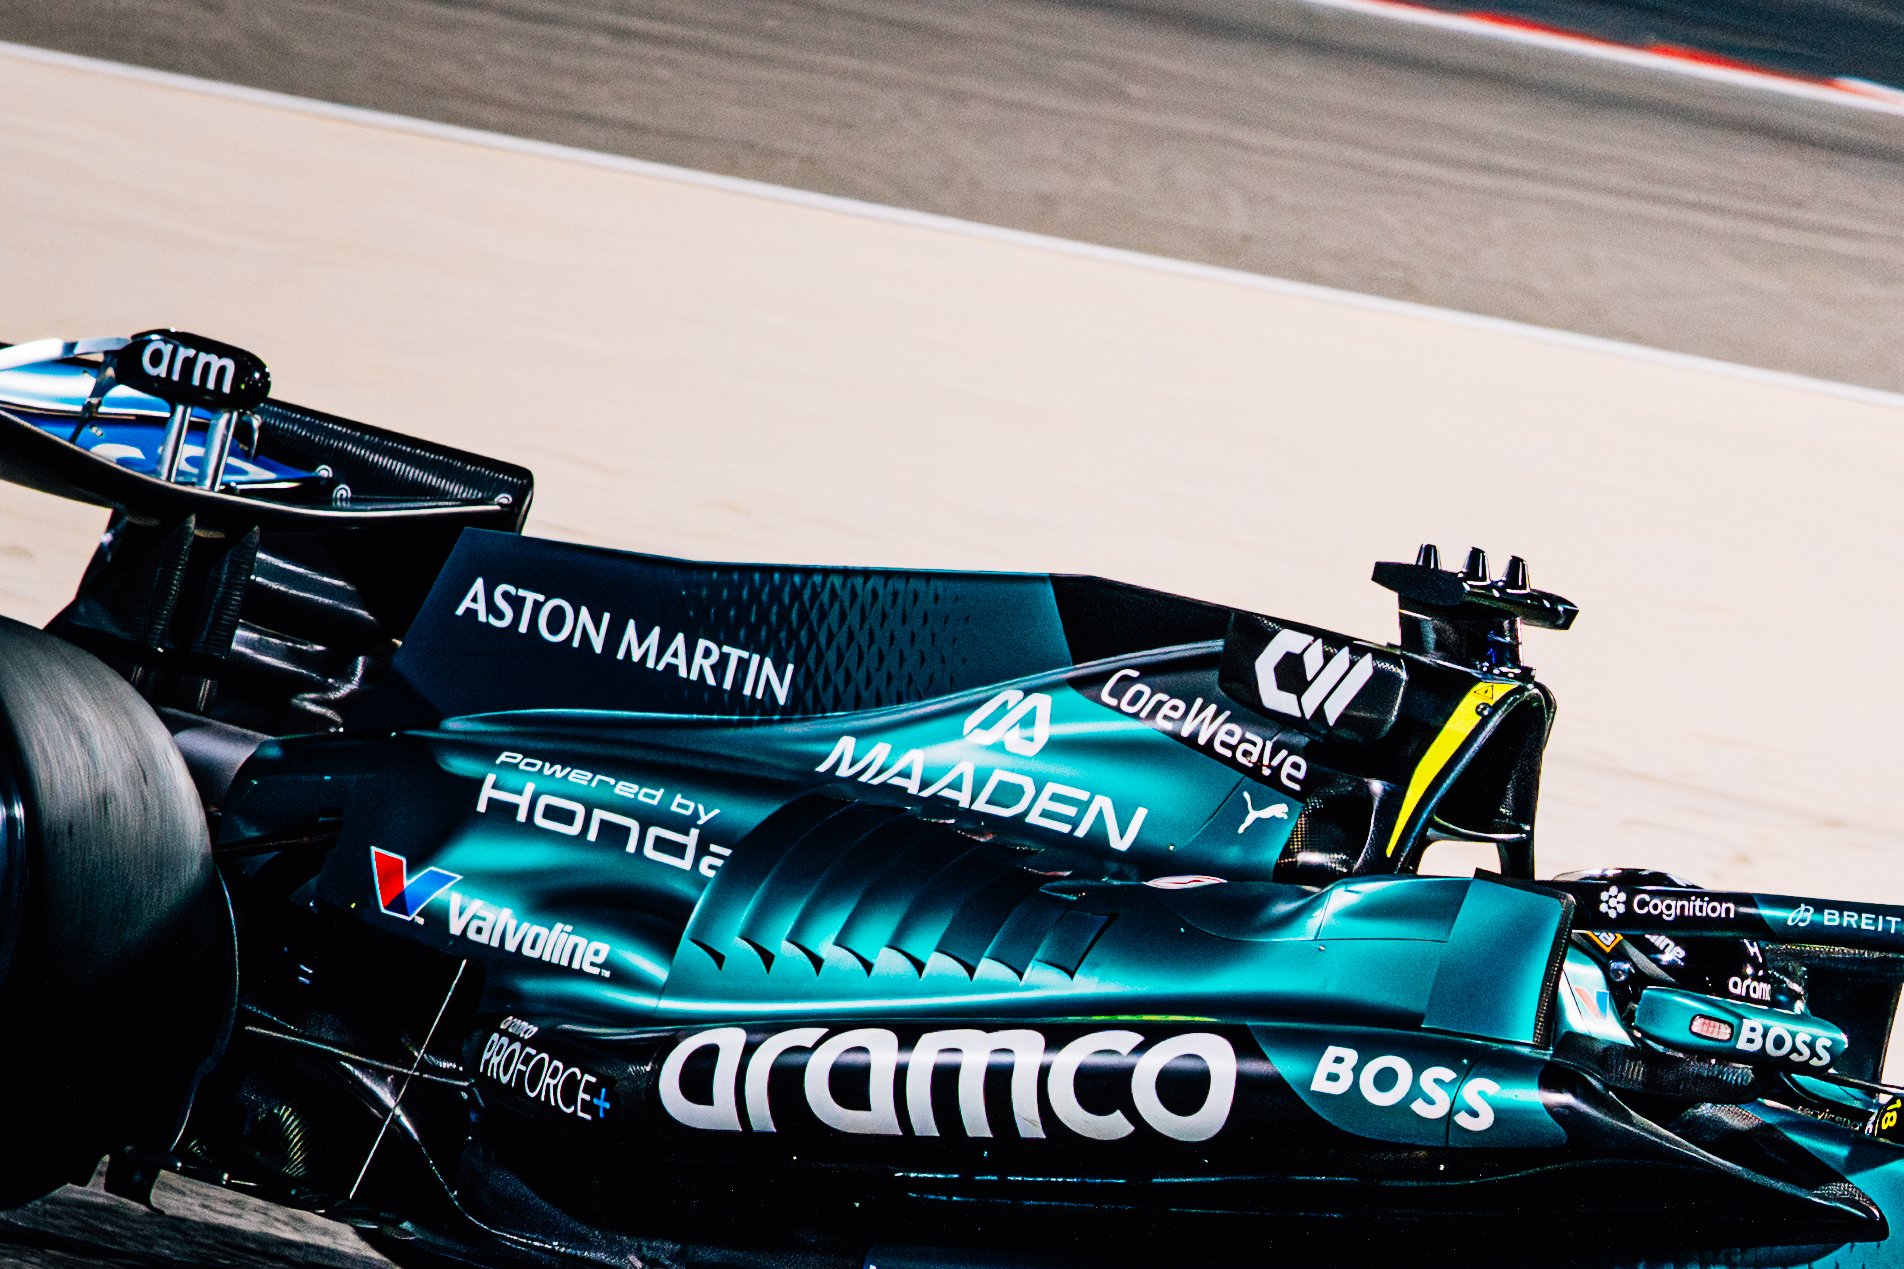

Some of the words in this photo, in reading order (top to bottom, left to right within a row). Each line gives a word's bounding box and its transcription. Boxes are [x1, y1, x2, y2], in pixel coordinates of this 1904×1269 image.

[142, 339, 235, 394] arm
[455, 576, 611, 654] ASTON
[616, 618, 794, 706] MARTIN
[1100, 668, 1308, 791] CoreWeave
[495, 751, 664, 806] Powered
[670, 793, 720, 825] by
[815, 735, 1148, 852] MAADEN
[449, 891, 611, 977] Valvoline
[1632, 893, 1735, 921] Cognition
[658, 1026, 1237, 1142] aramco
[1735, 1018, 1833, 1067] BOSS
[1310, 1045, 1501, 1131] BOSS
